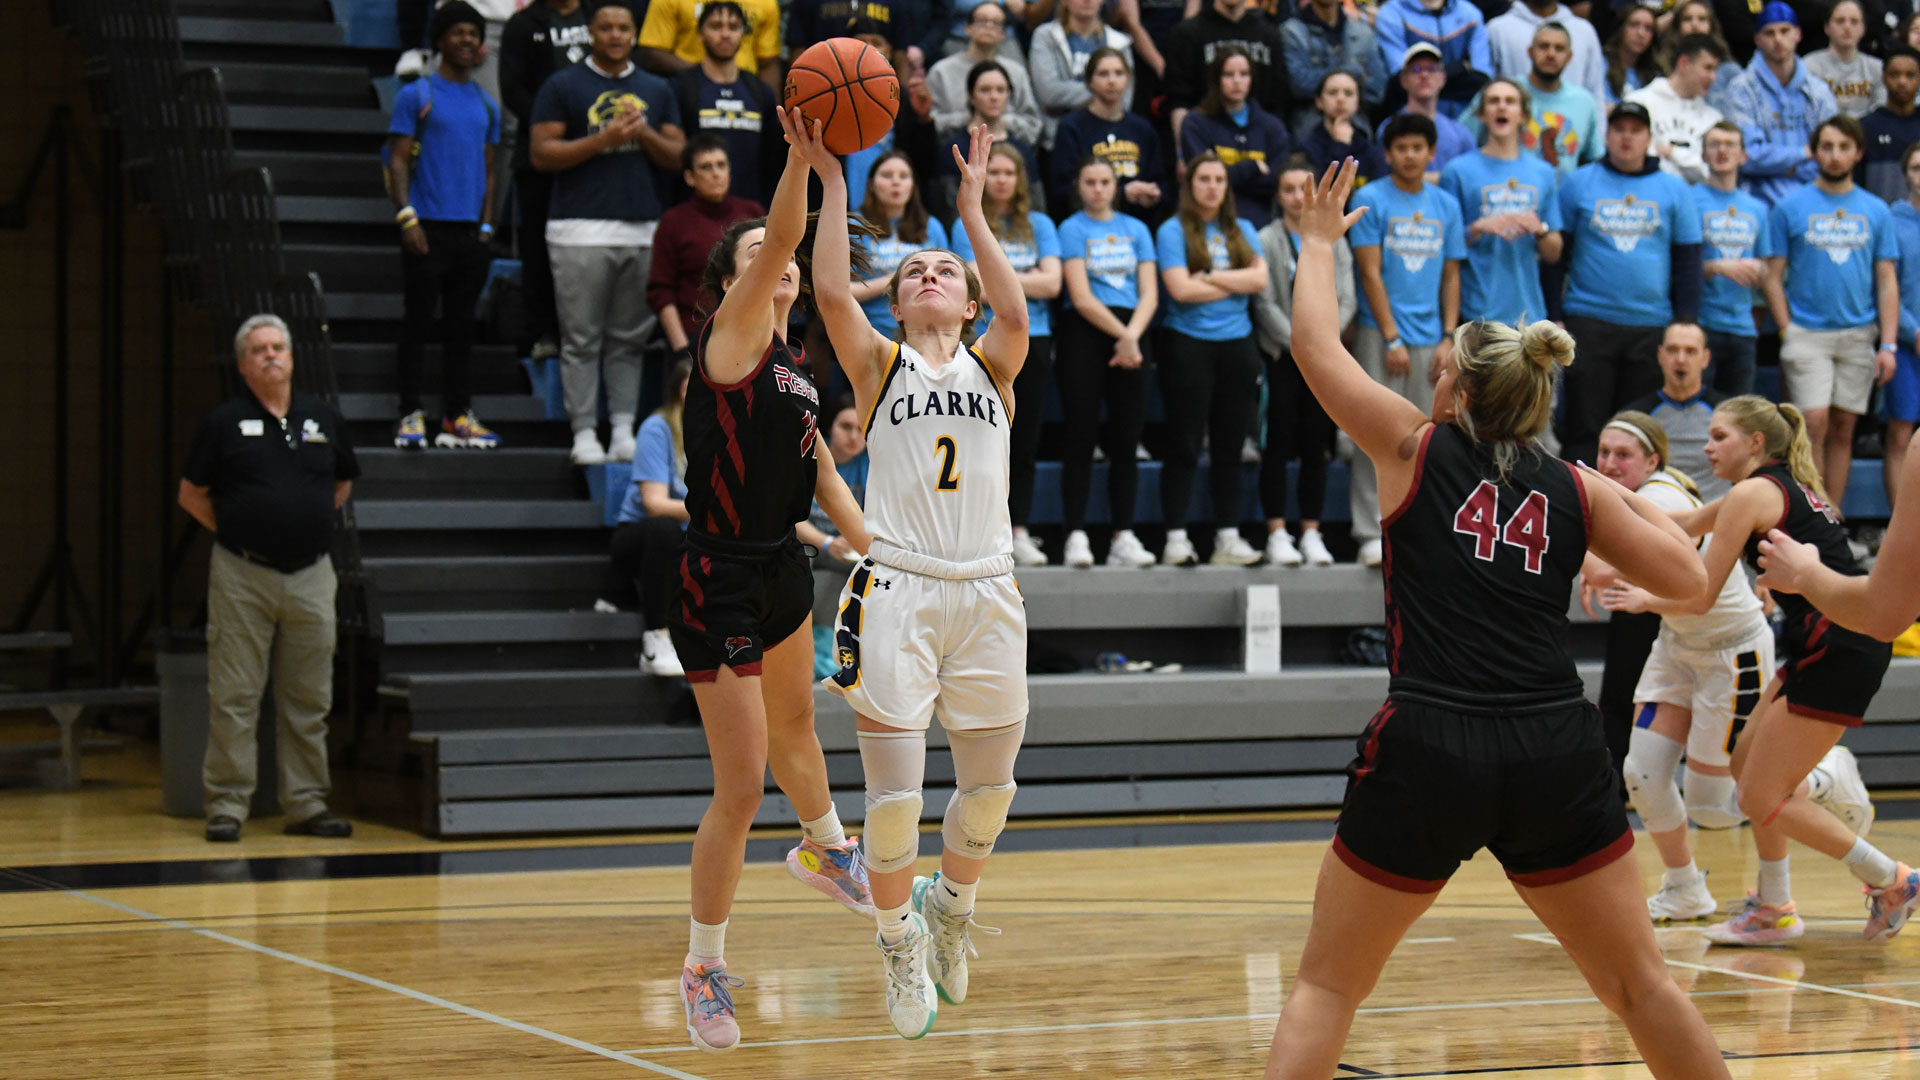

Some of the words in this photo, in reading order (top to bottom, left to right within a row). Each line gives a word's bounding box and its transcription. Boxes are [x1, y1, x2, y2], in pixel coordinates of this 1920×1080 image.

[890, 390, 998, 428] CLARKE
[933, 434, 962, 492] 2
[1453, 479, 1550, 575] 44
